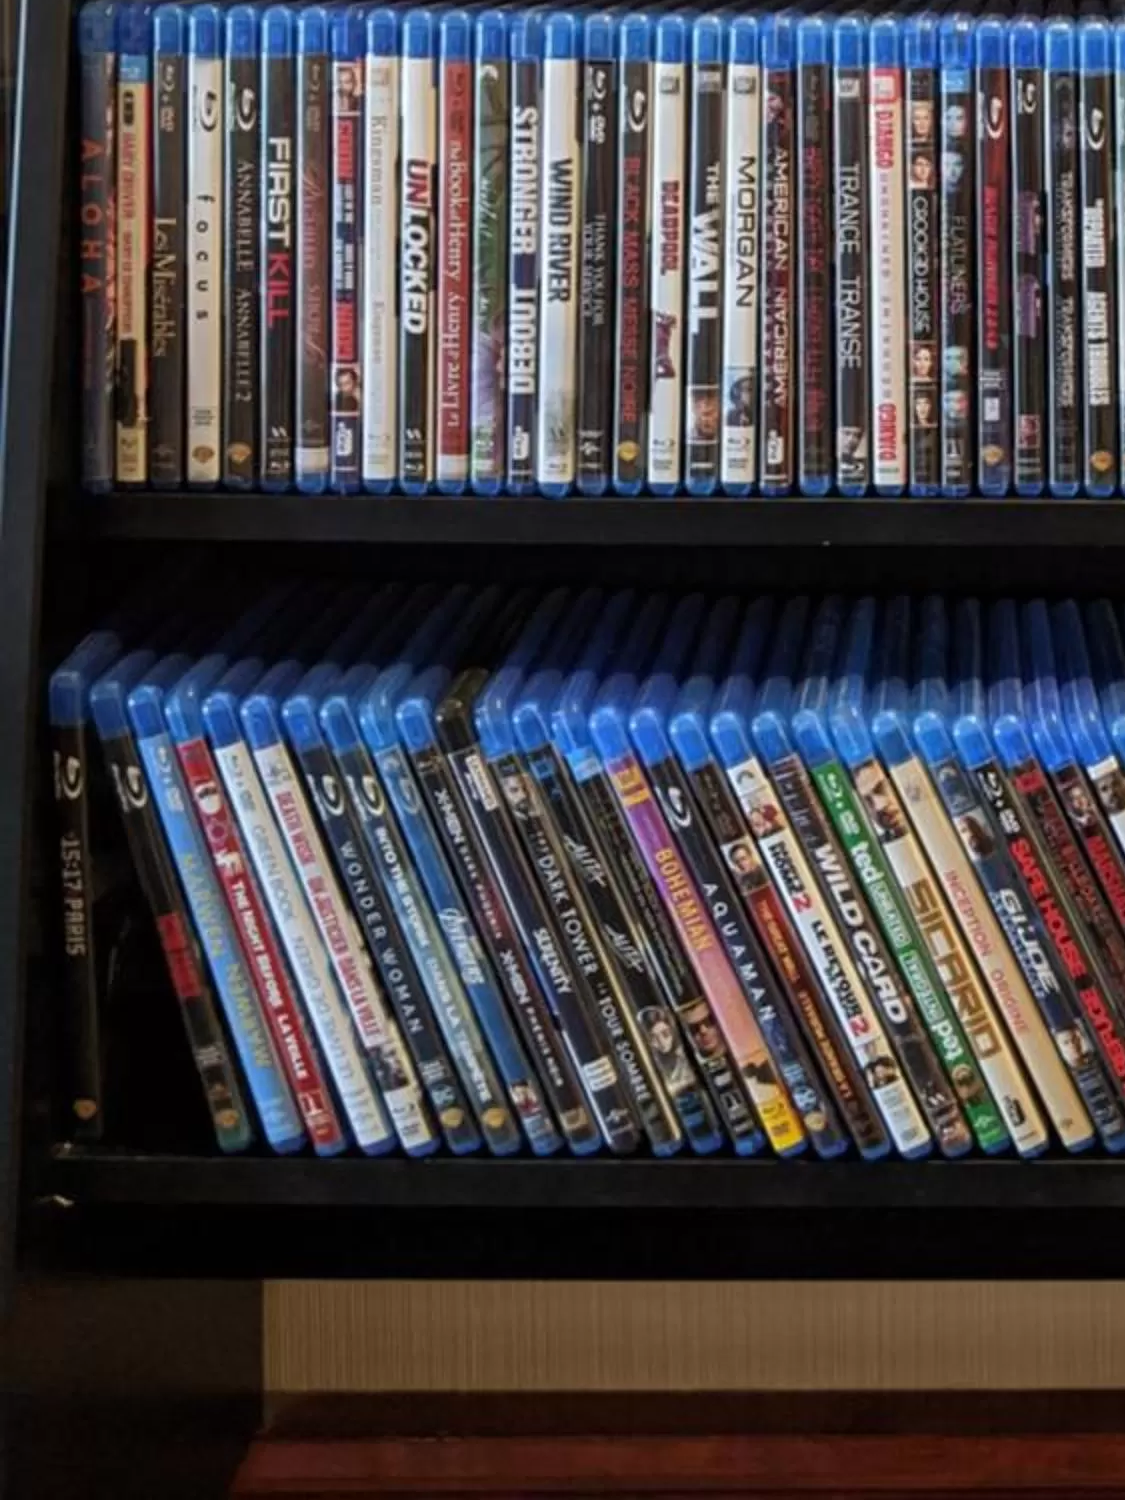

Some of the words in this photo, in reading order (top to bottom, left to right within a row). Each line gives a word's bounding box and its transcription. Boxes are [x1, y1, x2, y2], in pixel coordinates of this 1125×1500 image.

[511, 106, 538, 255] STRONGER
[622, 157, 642, 222] BLACK
[704, 163, 722, 205] THE
[875, 110, 895, 171] DJANGO
[152, 217, 178, 252] Les
[234, 158, 256, 273] ANNABELLE
[268, 136, 292, 249] FIRST
[547, 158, 574, 228] WIND
[660, 180, 681, 277] DEADPOOL
[735, 155, 759, 309] MORGAN
[773, 147, 790, 273] AMERICAN
[839, 162, 862, 255] TRANCE
[267, 252, 291, 329] KILL
[403, 158, 433, 336] UNLOCKED
[546, 234, 573, 304] RIVER
[622, 231, 642, 287] MASS
[689, 210, 720, 336] WALL
[151, 251, 178, 358] Misérables
[233, 286, 253, 388] ANNABELLE
[510, 284, 536, 395] DEBOUT
[621, 297, 639, 355] MESSE
[838, 276, 862, 370] TRANSE
[233, 390, 251, 402] 2
[621, 364, 638, 423] NOIRE
[61, 843, 84, 890] 15:17
[436, 788, 464, 843] X-MEN
[501, 950, 529, 1004] X-MEN
[656, 848, 709, 952] BOHEMIAN
[852, 840, 882, 883] ted
[1010, 837, 1047, 898] SAFE
[1040, 897, 1086, 978] HOUSE
[64, 897, 88, 958] PARIS
[341, 842, 382, 938] WONDER
[383, 948, 420, 1033] WOMAN
[534, 927, 570, 994] SERENITY
[539, 855, 566, 902] DARK
[562, 908, 596, 975] TOWER
[600, 996, 623, 1036] TOUR
[618, 1040, 648, 1101] SOMBRE
[704, 880, 774, 1022] AQUAMAN
[812, 920, 826, 942] LE
[823, 944, 859, 1017] RETOUR
[813, 841, 864, 928] WILD
[851, 931, 908, 1024] CARD
[906, 879, 999, 1060] SICARIO
[946, 869, 991, 956] INCEPTION
[991, 968, 1027, 1036] ORIGINE
[233, 882, 248, 907] THE
[243, 911, 262, 952] NIGHT
[258, 954, 281, 1007] BEFORE
[279, 1014, 291, 1032] LA
[285, 1034, 306, 1079] VEILLE
